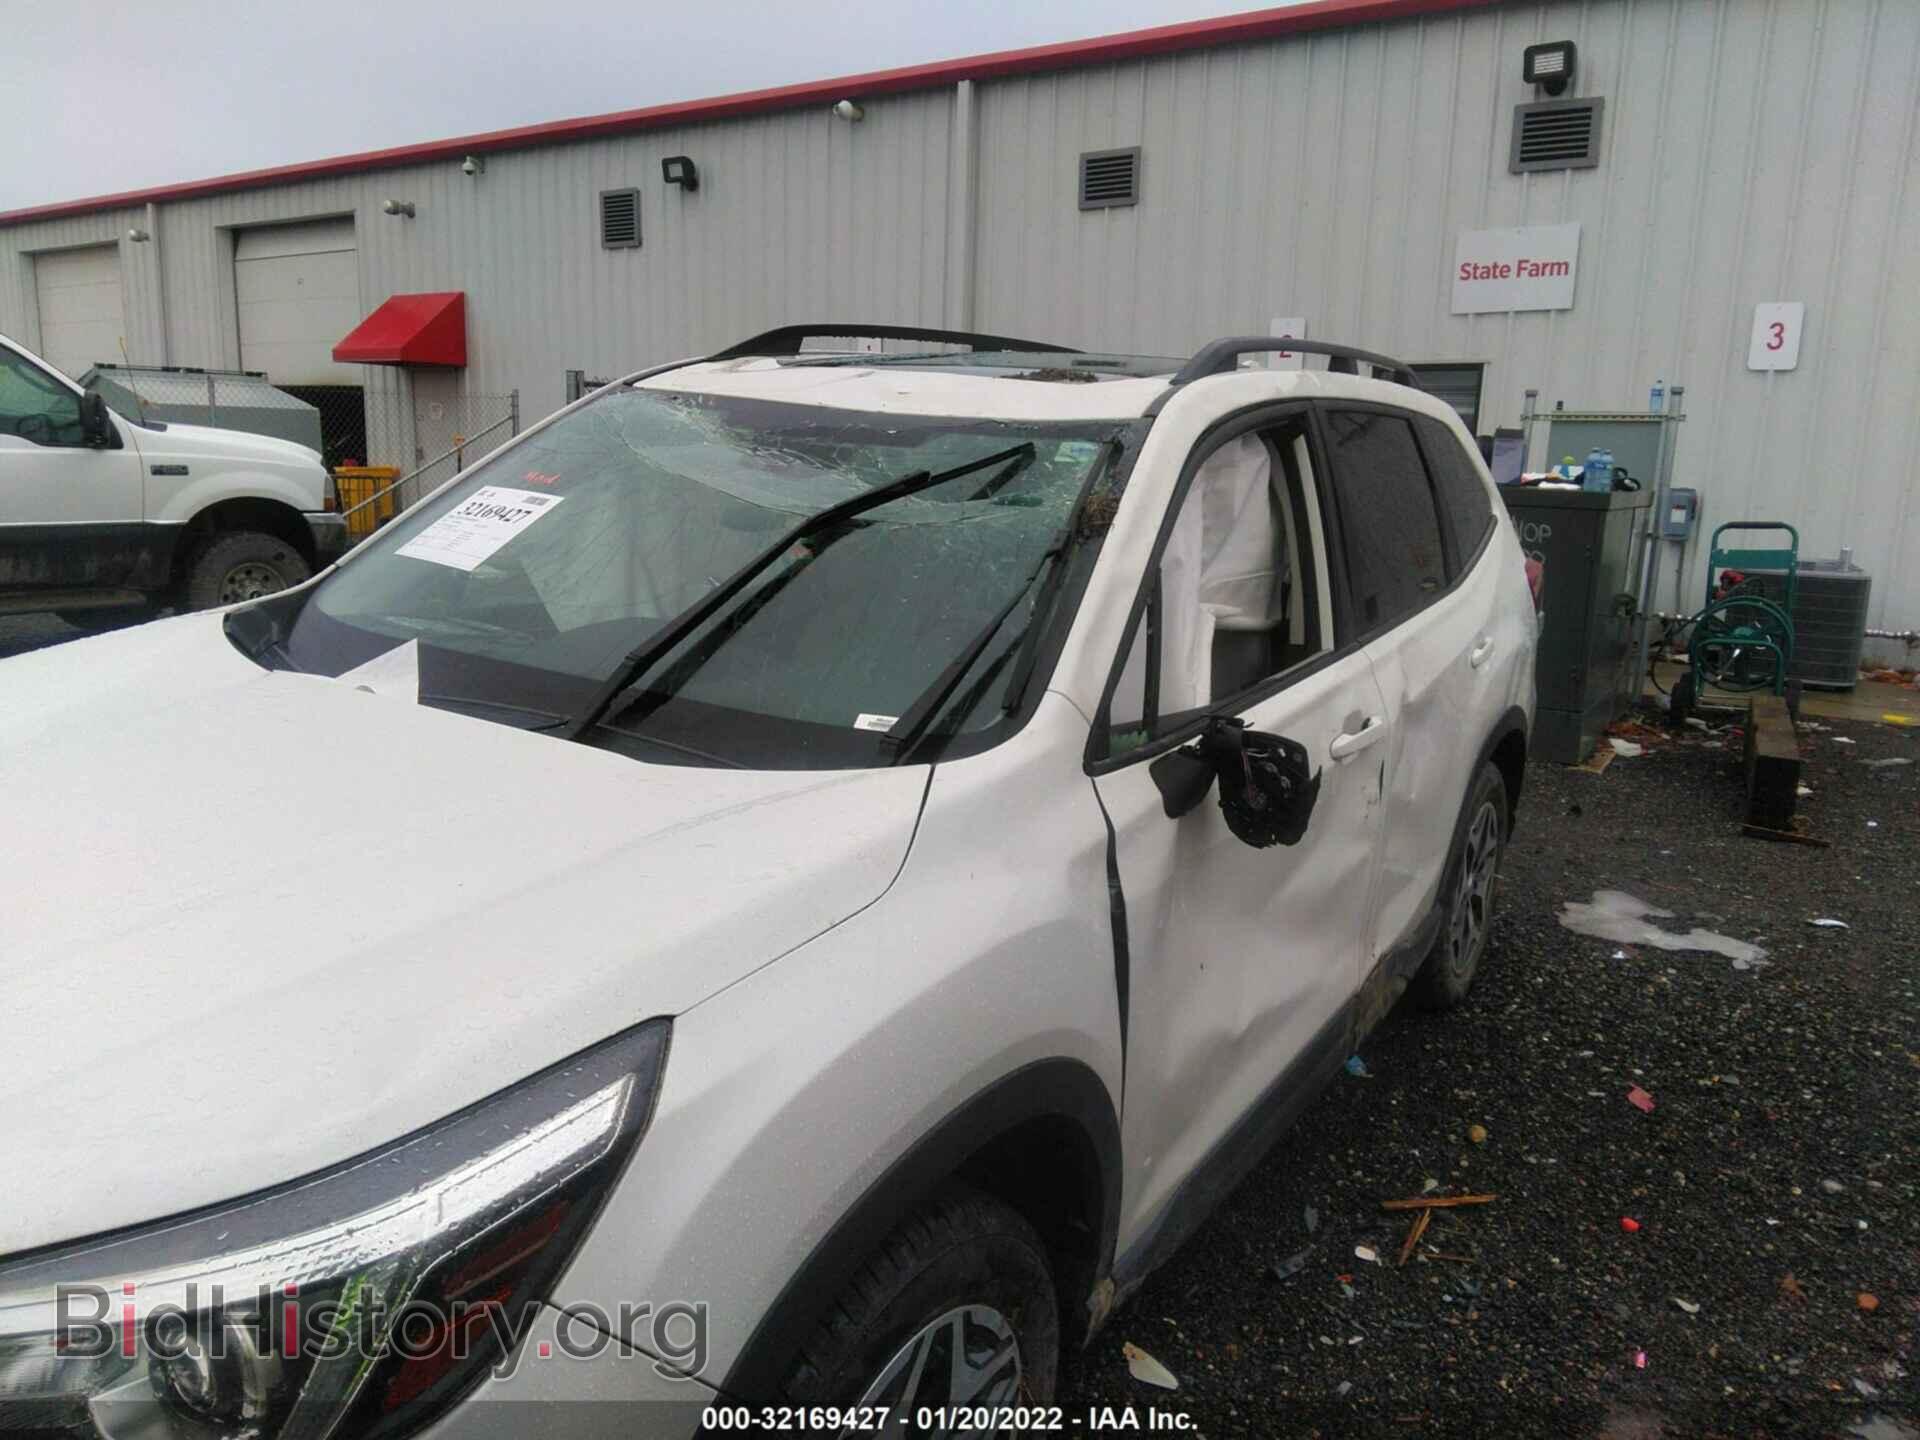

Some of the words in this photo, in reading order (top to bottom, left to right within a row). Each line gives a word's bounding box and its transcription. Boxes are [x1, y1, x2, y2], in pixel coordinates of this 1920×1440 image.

[1459, 261, 1511, 281] State
[1516, 259, 1569, 278] Farm
[1766, 322, 1785, 351] 3
[457, 501, 532, 524] 32169427
